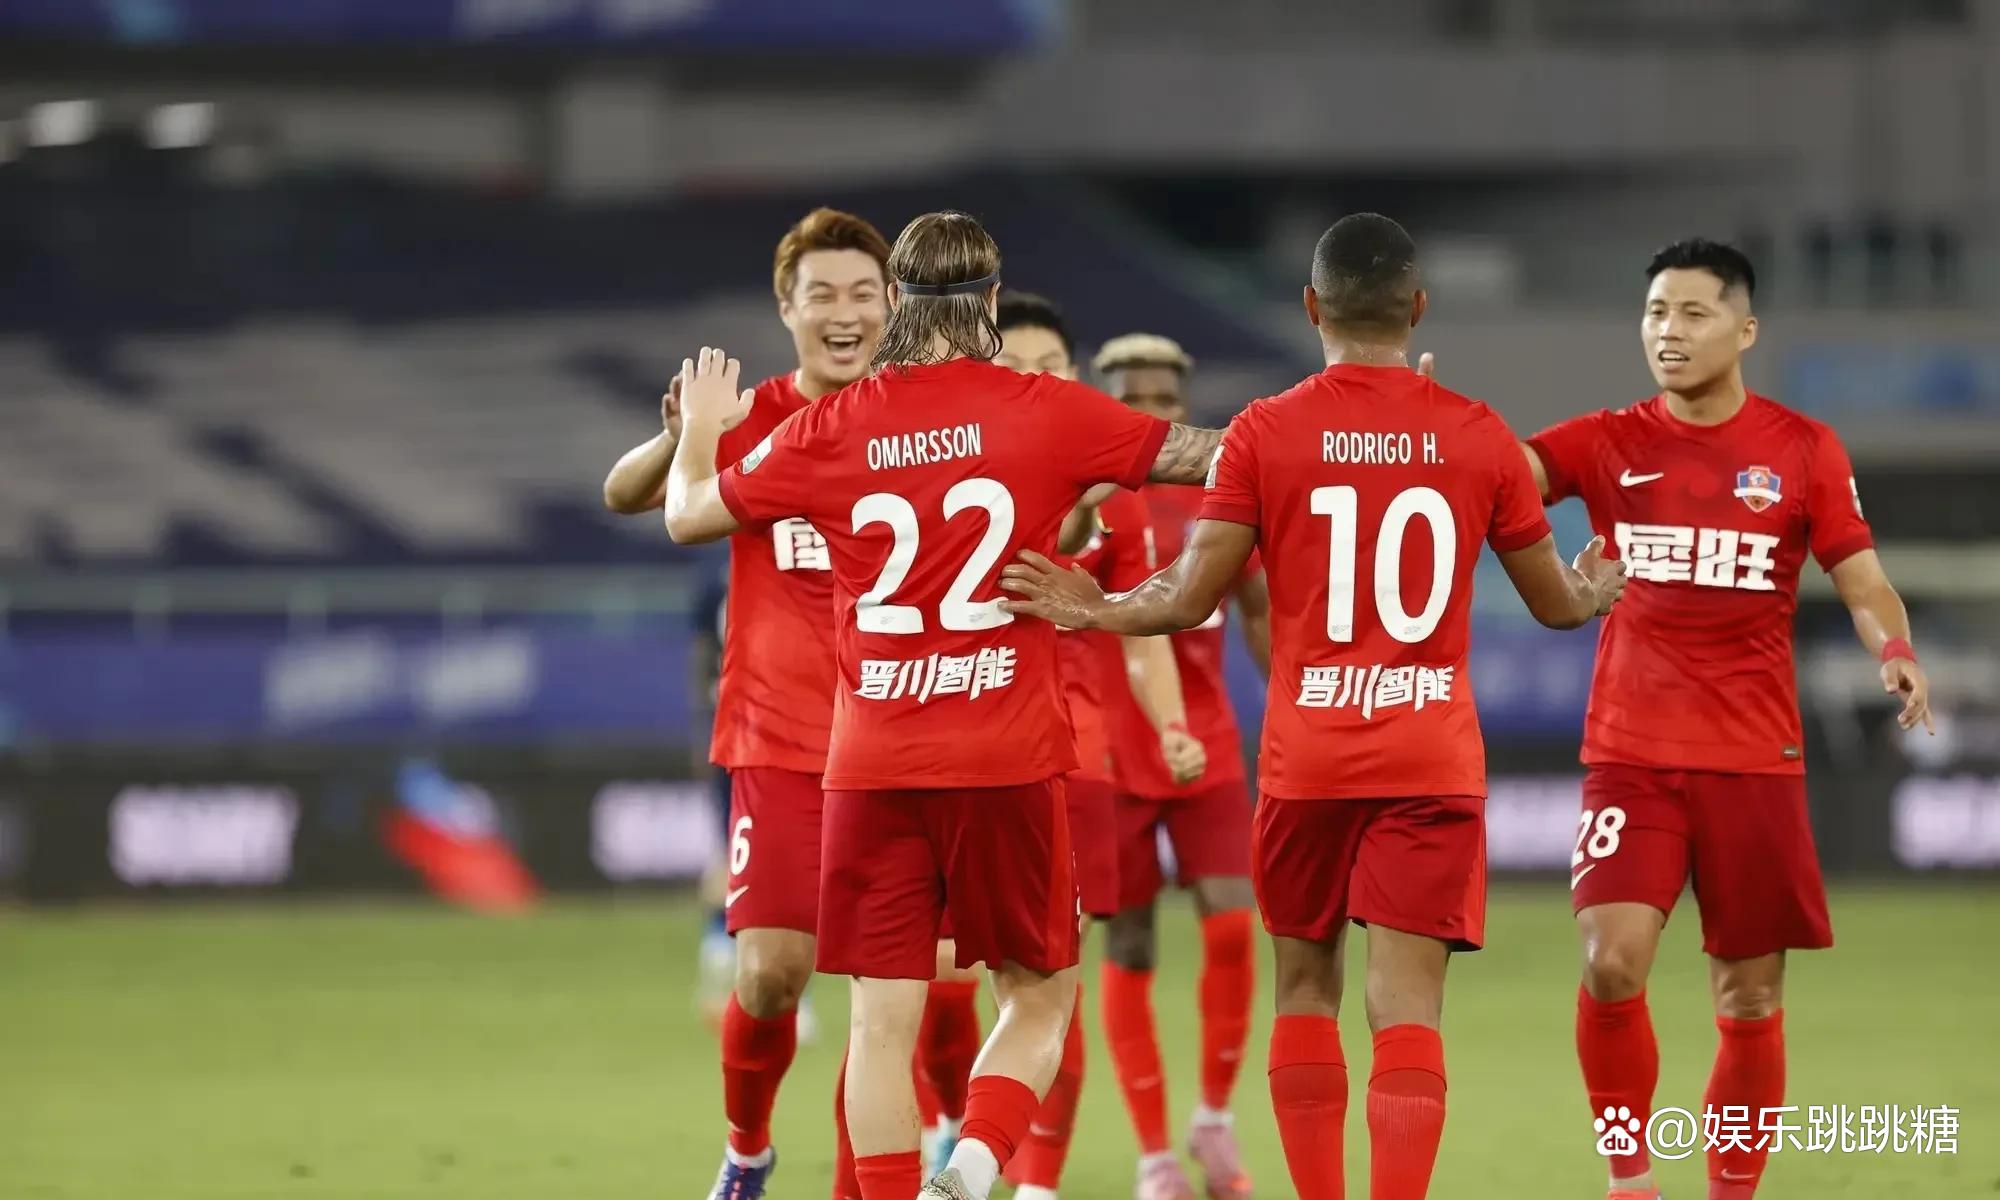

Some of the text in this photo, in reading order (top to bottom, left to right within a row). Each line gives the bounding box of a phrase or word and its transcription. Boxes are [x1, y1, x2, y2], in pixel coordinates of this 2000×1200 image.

[866, 422, 982, 471] OMARSSON
[1322, 430, 1445, 465] RODRIGO H.
[851, 477, 1016, 635] 22
[1310, 485, 1457, 644] 10
[1614, 521, 1781, 591] 犀旺
[852, 646, 1018, 705] 晋川智能
[1295, 663, 1455, 721] 晋川智能
[1570, 805, 1627, 869] 28
